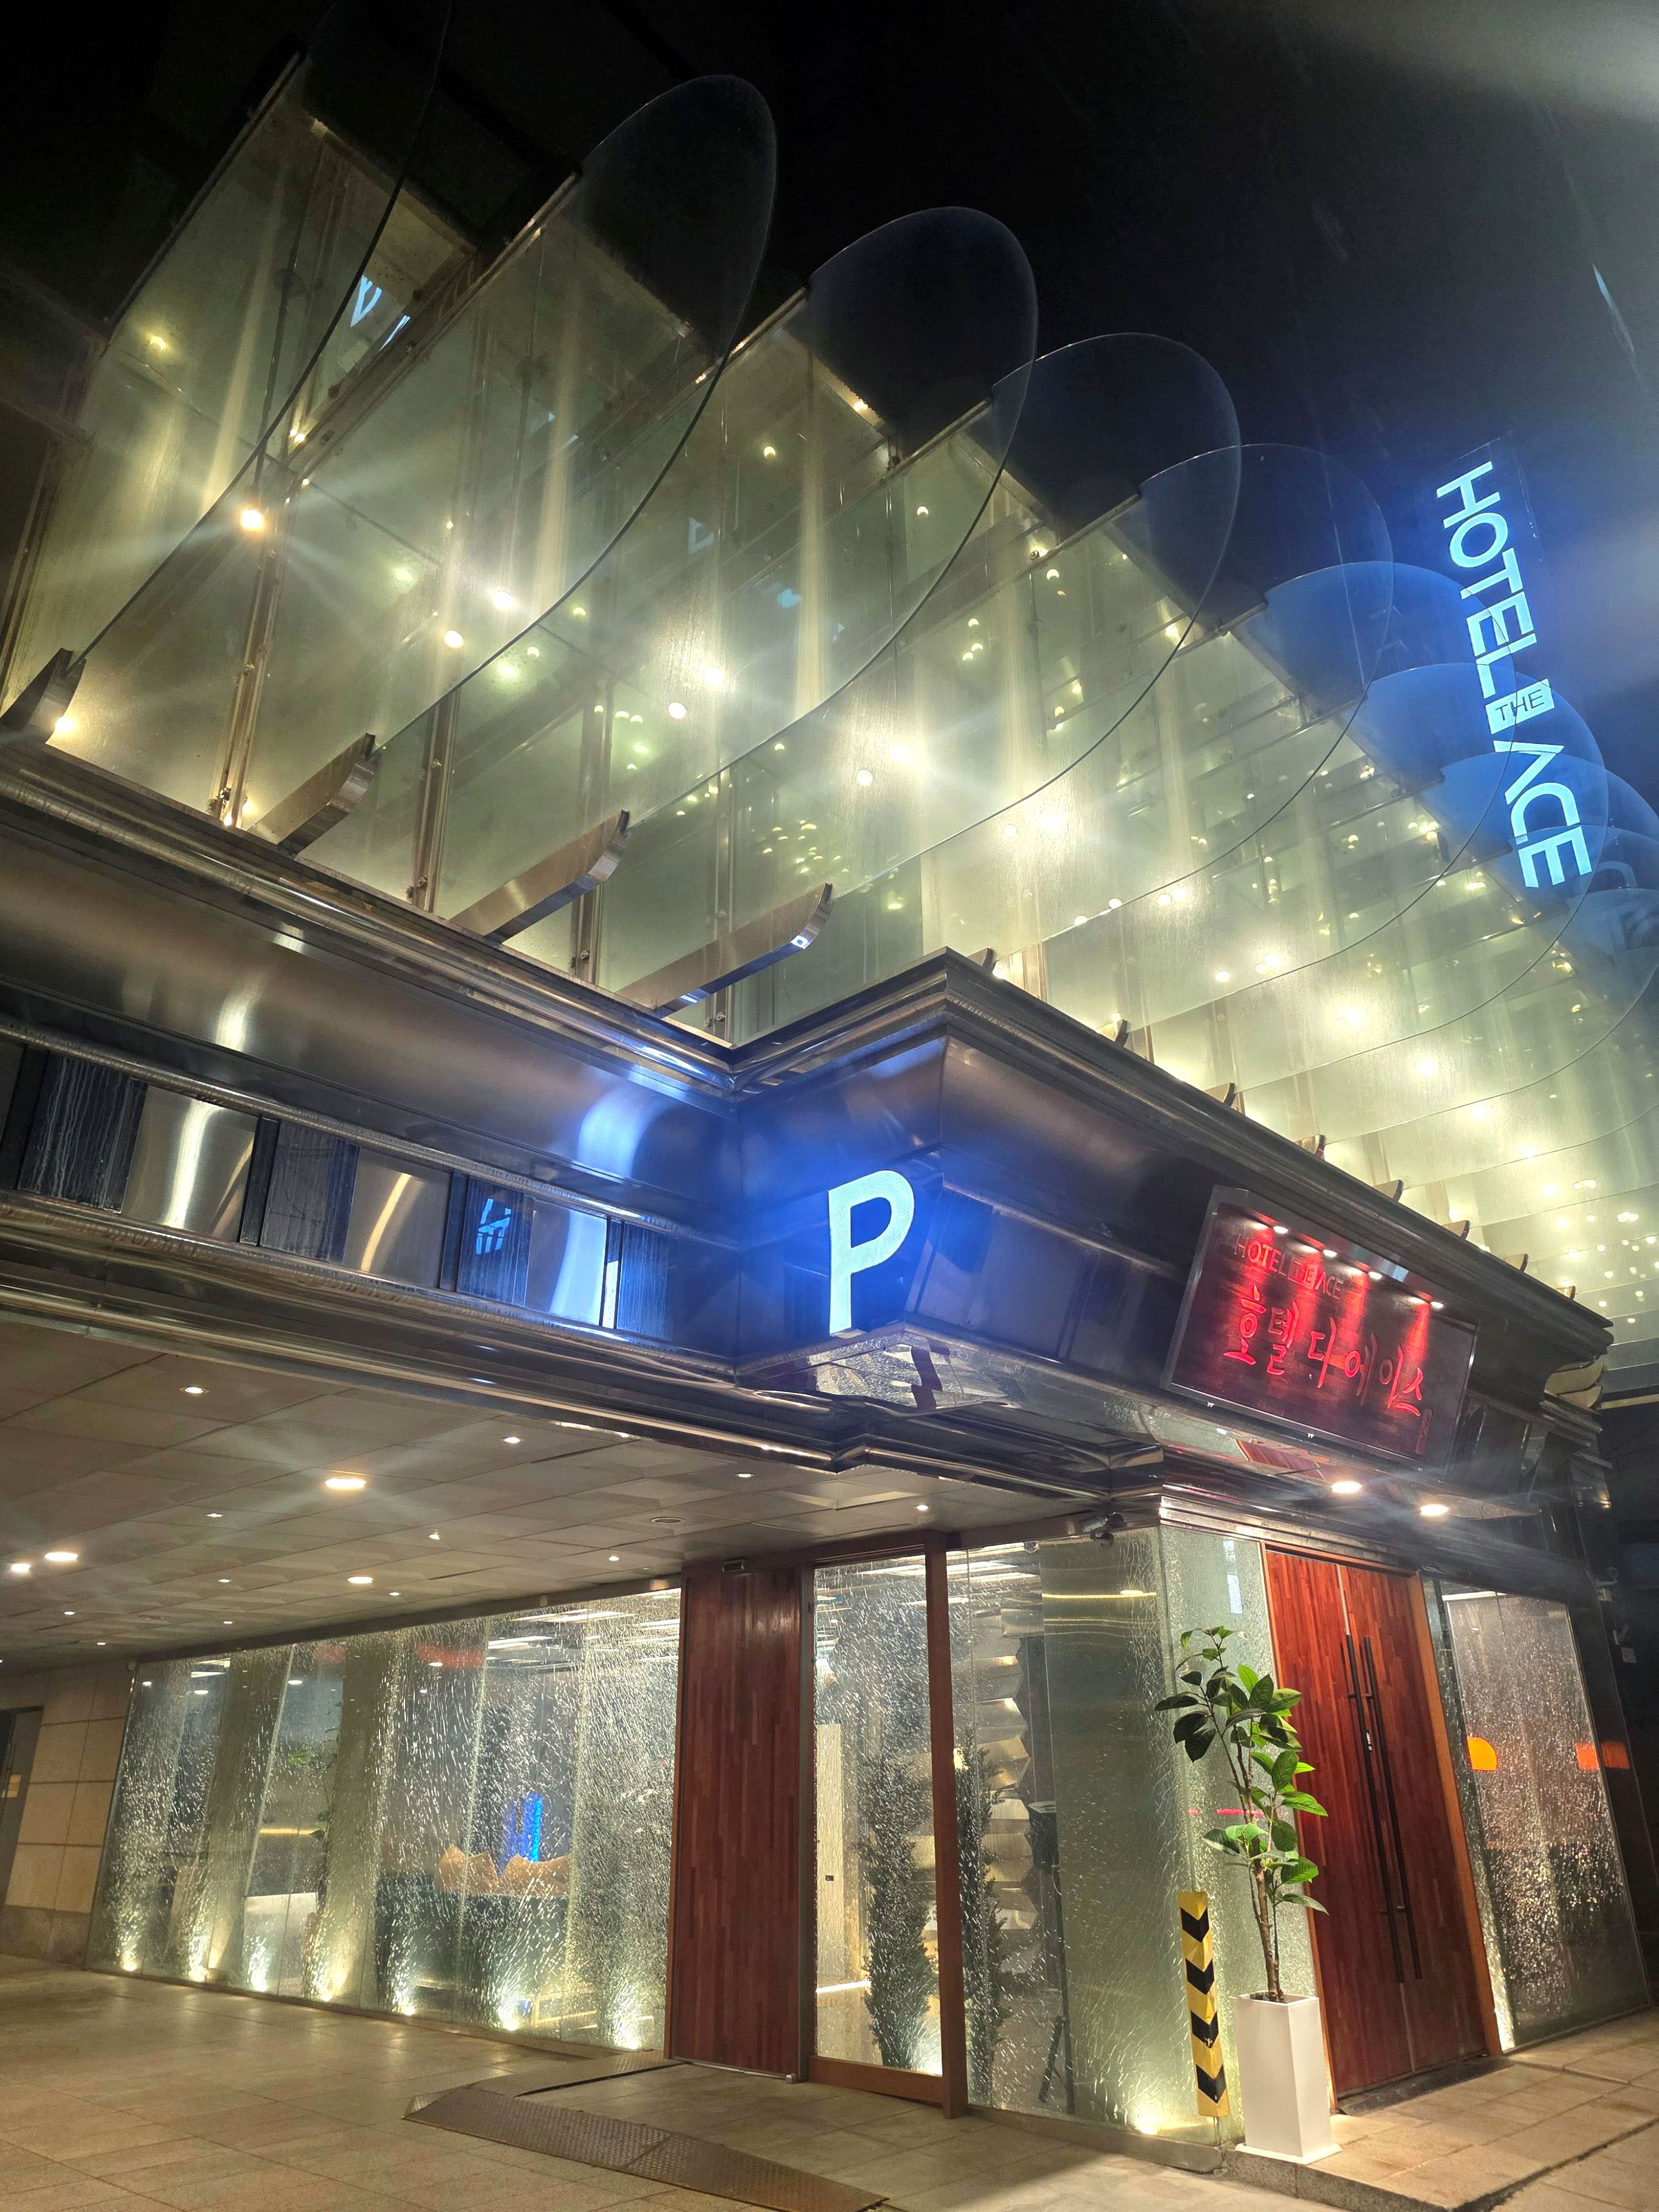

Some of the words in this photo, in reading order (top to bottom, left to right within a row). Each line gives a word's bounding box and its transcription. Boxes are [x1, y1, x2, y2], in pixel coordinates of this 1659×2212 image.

[1436, 461, 1537, 699] HOTEL
[1495, 689, 1546, 725] THE
[828, 1169, 915, 1335] P
[1234, 1233, 1287, 1277] HOTEL
